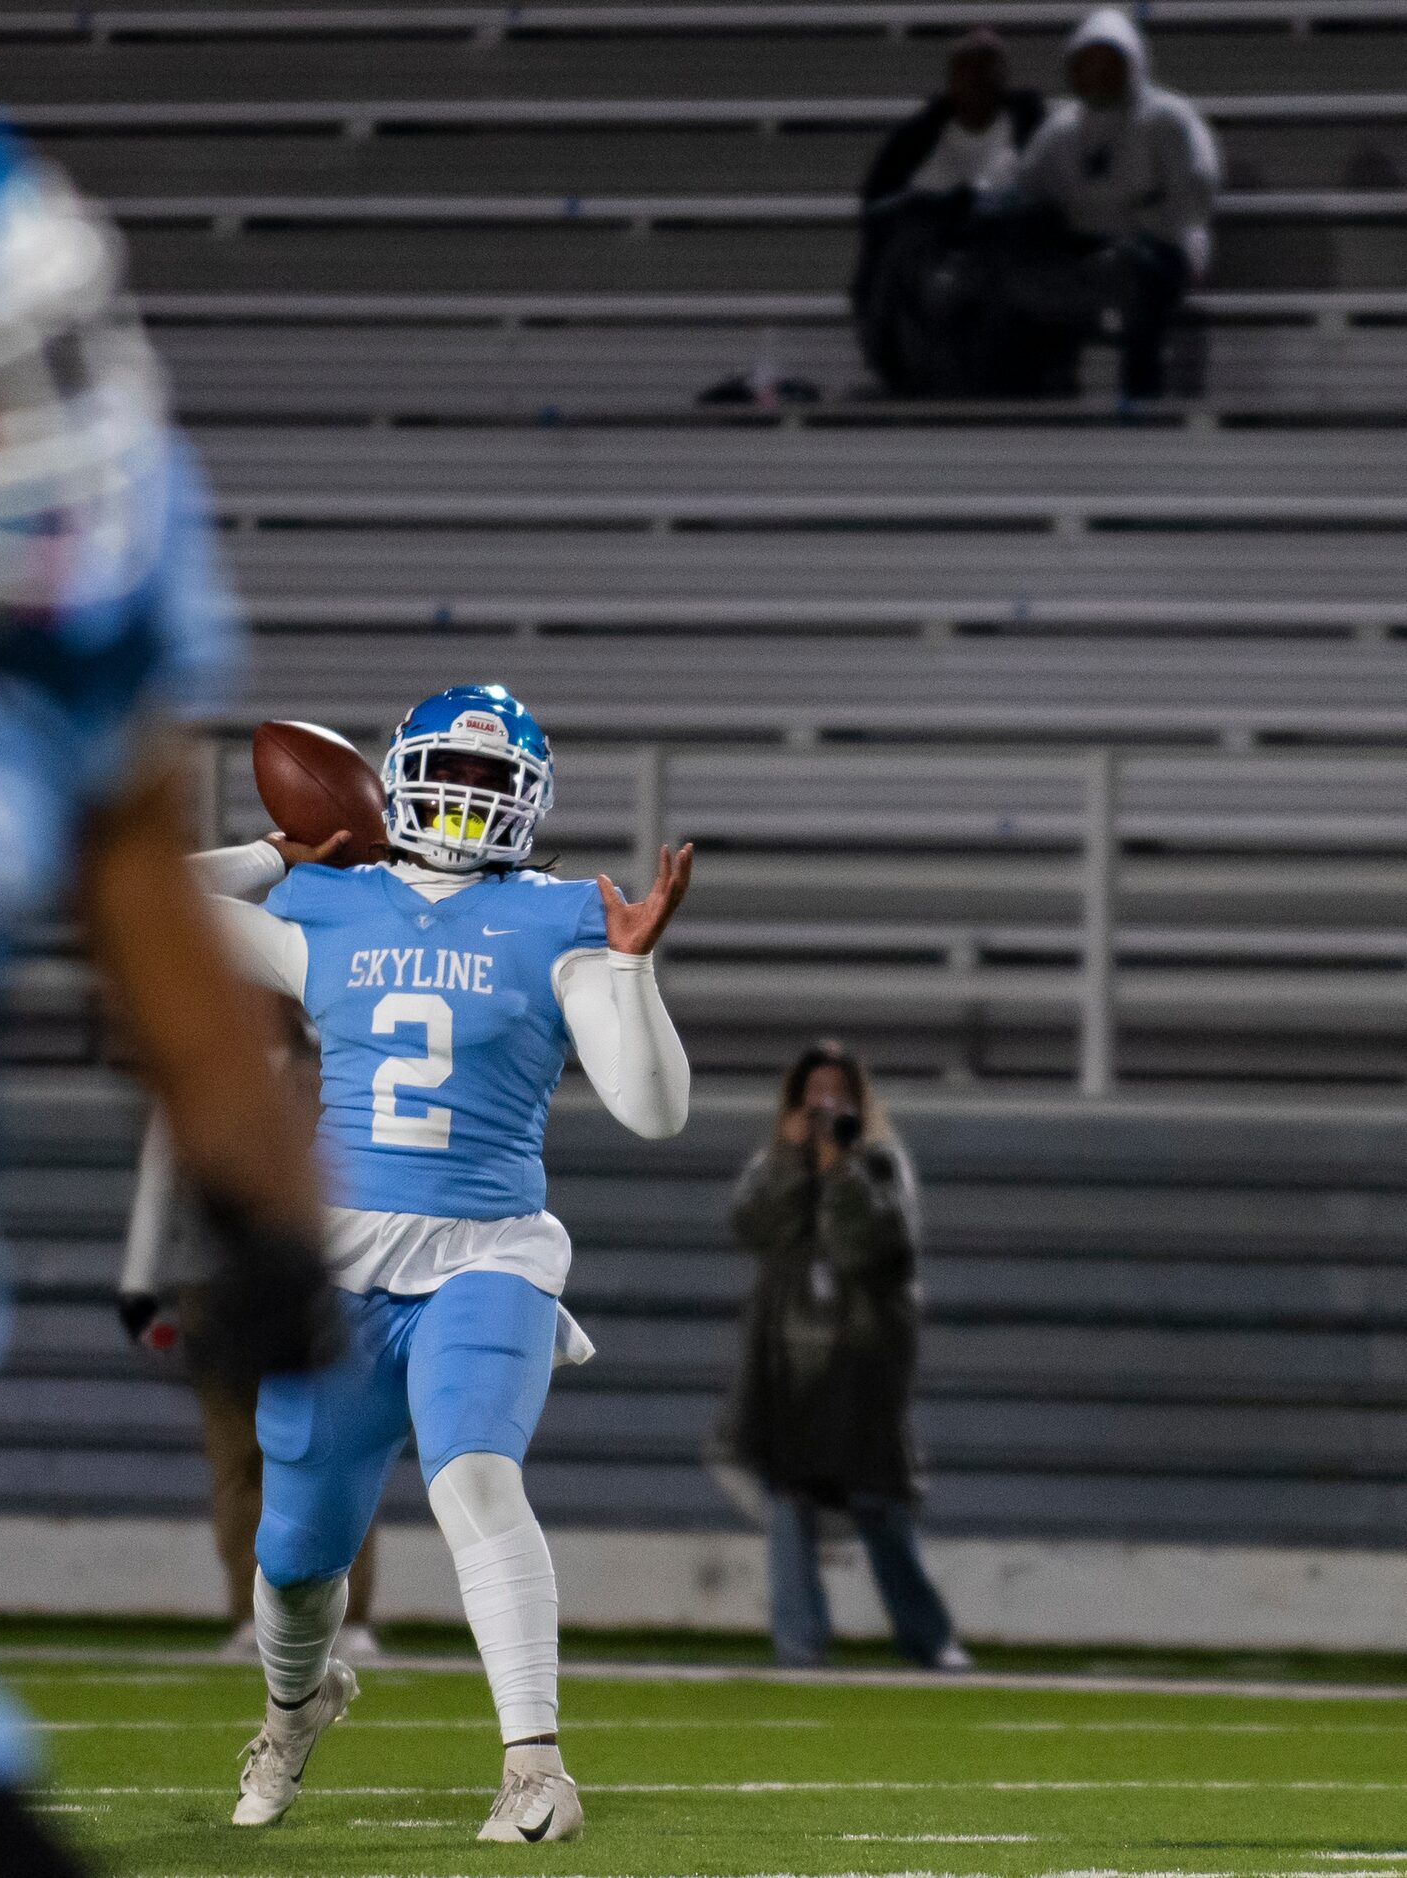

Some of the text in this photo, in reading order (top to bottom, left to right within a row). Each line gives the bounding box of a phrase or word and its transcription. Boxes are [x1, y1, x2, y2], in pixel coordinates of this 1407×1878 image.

[466, 719, 496, 732] DALLAS
[348, 948, 493, 994] SKYLINE
[371, 993, 453, 1149] 2
